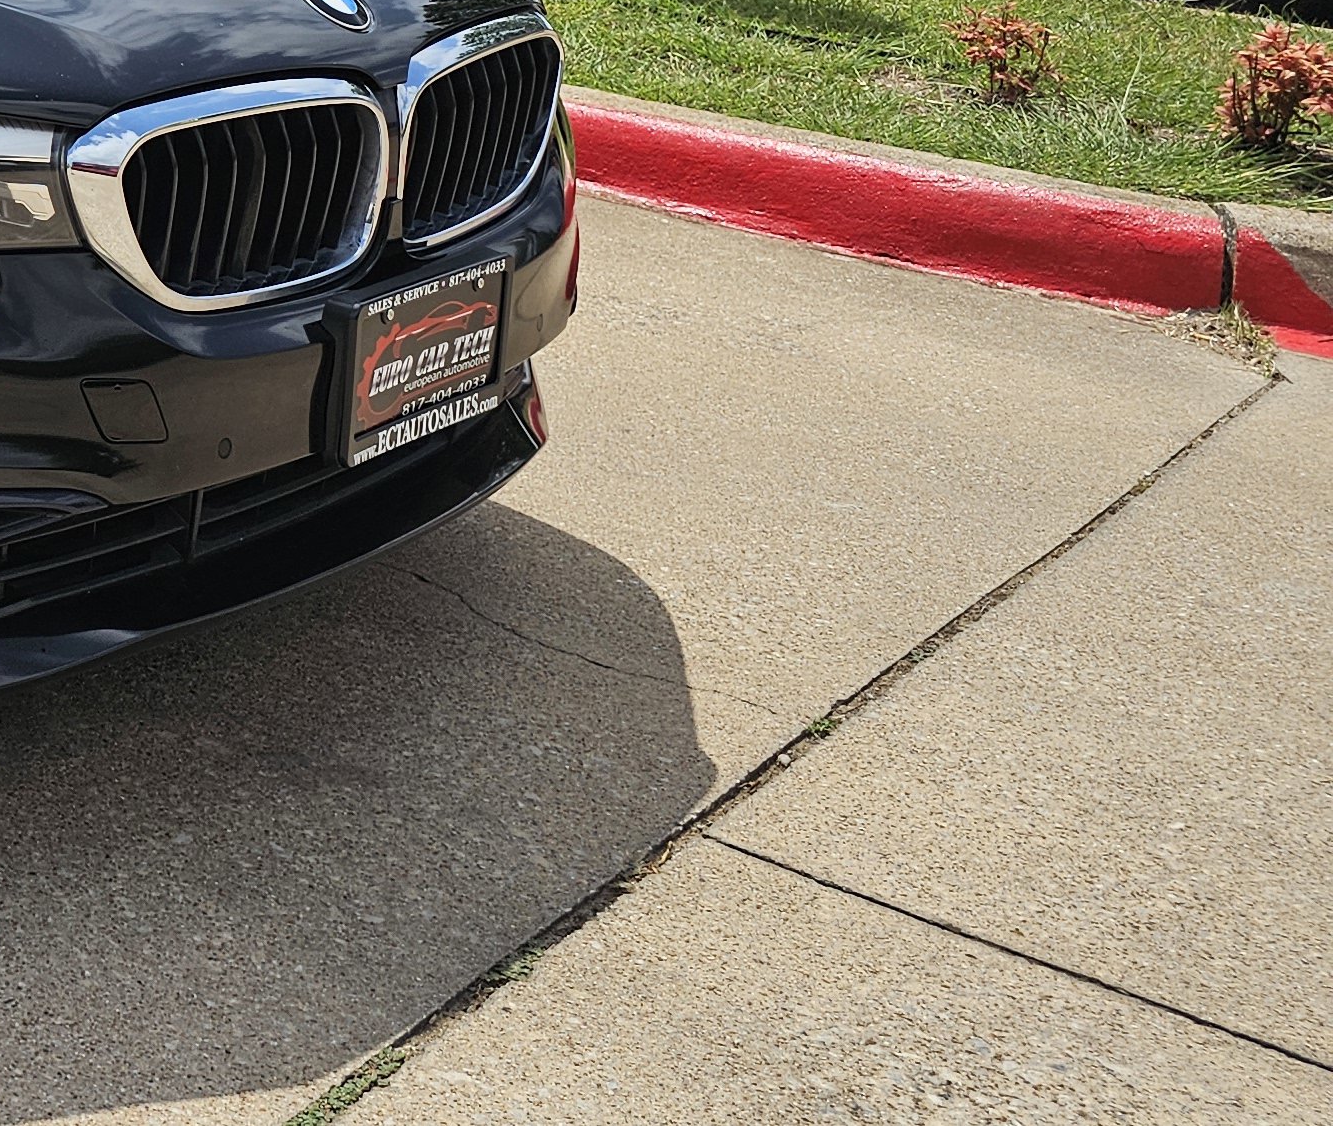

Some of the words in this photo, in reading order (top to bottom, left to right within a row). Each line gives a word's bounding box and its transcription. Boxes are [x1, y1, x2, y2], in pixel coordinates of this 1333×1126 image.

[367, 298, 393, 316] SALES
[394, 294, 401, 306] &
[402, 281, 439, 303] SERVICE
[448, 259, 506, 288] 817-404-4033
[369, 355, 413, 397] EURO
[415, 341, 449, 376] CAR
[451, 326, 495, 362] TECH
[404, 368, 443, 393] european
[443, 354, 490, 377] automotive
[402, 374, 486, 416] 817-404-4033
[353, 393, 498, 466] www.ECTAUTOSALES.com
